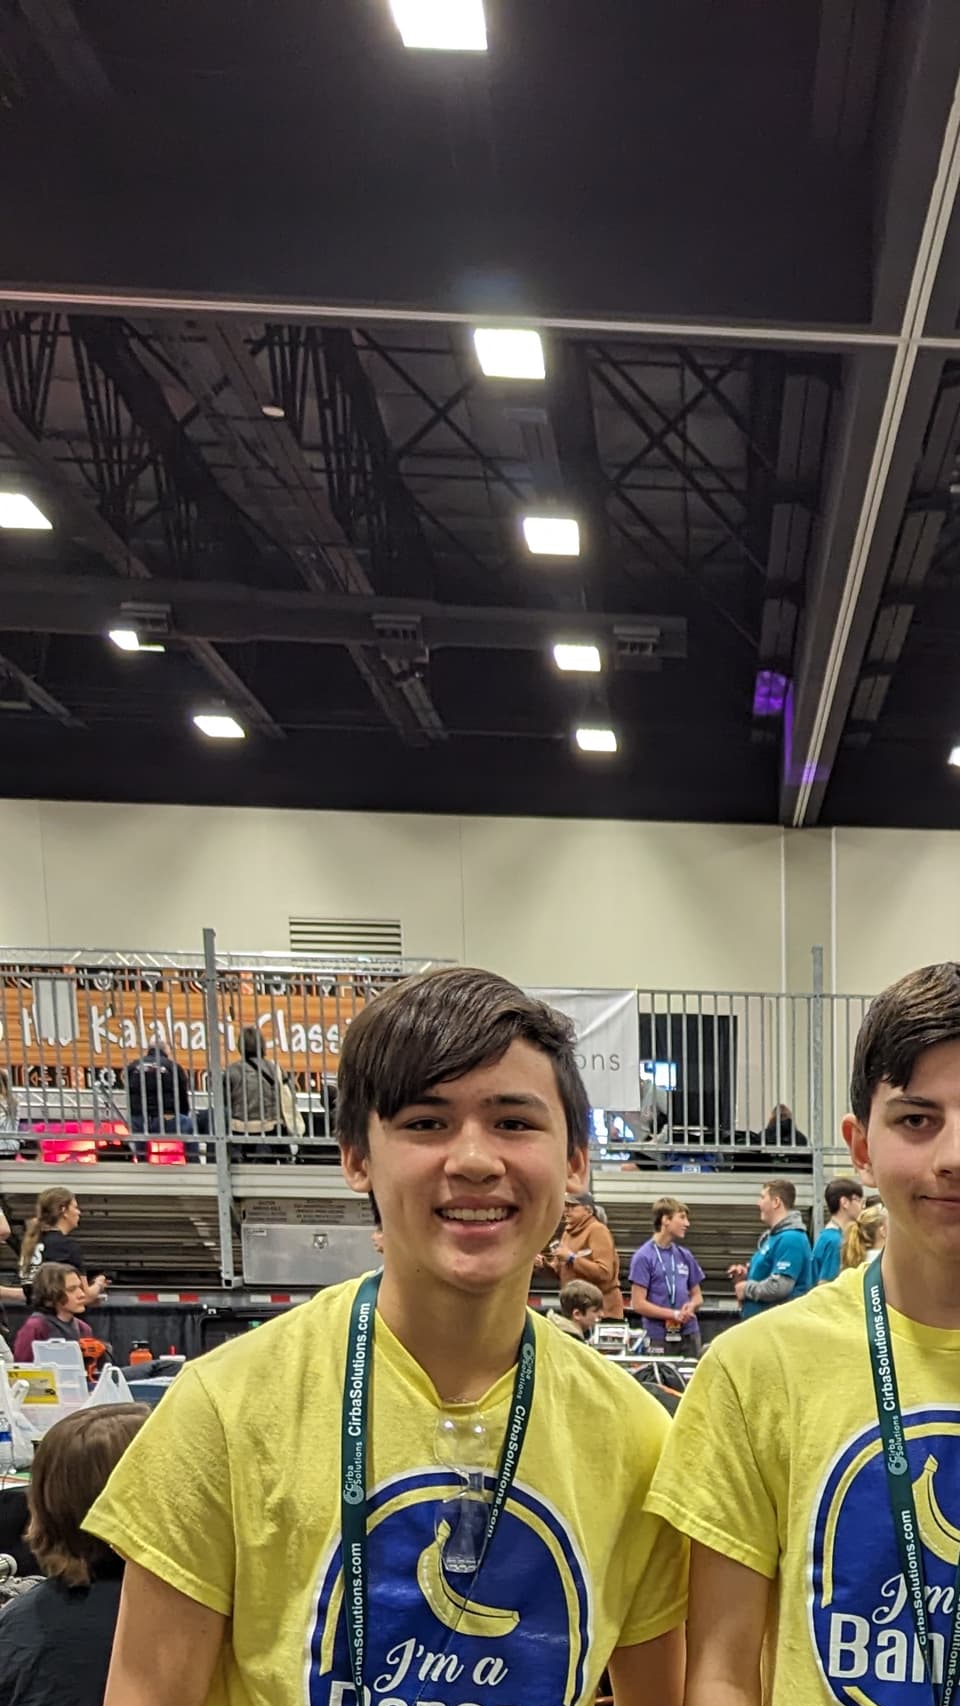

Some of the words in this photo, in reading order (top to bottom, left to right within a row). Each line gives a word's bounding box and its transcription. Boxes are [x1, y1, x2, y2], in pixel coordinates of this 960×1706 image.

[90, 1004, 236, 1054] Kalahai
[256, 1008, 352, 1055] Class
[347, 1302, 371, 1437] CirbaSolutions.com
[869, 1285, 896, 1411] CirbaSolutions.com
[353, 1441, 363, 1487] Solutions
[487, 1404, 527, 1538] CirbaSolutions.com
[351, 1542, 364, 1687] CirbaSolutions.com
[871, 1573, 954, 1625] Im
[900, 1510, 928, 1647] CirbaSolutions.com
[373, 1637, 464, 1693] I'm
[472, 1655, 509, 1687] a
